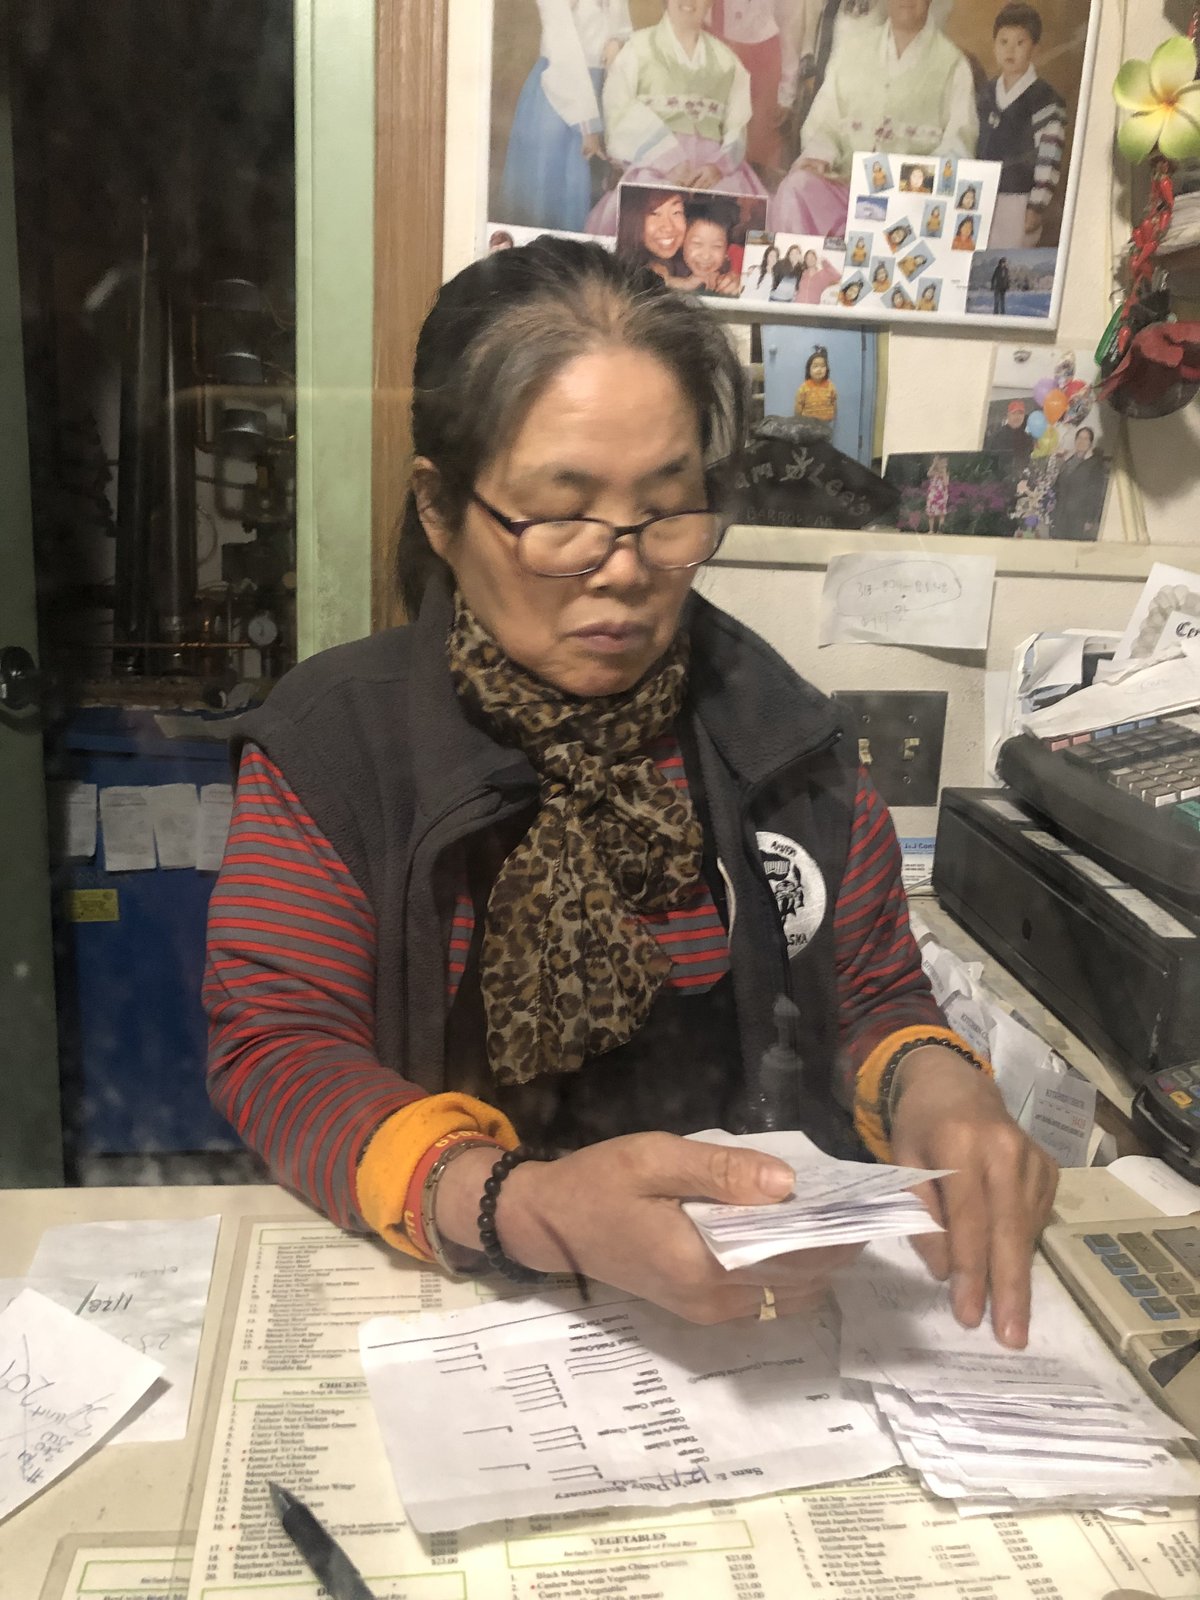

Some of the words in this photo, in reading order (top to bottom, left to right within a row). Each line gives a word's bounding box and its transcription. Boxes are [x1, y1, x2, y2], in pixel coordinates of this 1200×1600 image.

[650, 1396, 675, 1407] Total
[673, 1435, 698, 1445] Total
[730, 1466, 764, 1478] Sam
[591, 1533, 667, 1546] VEGETABLES
